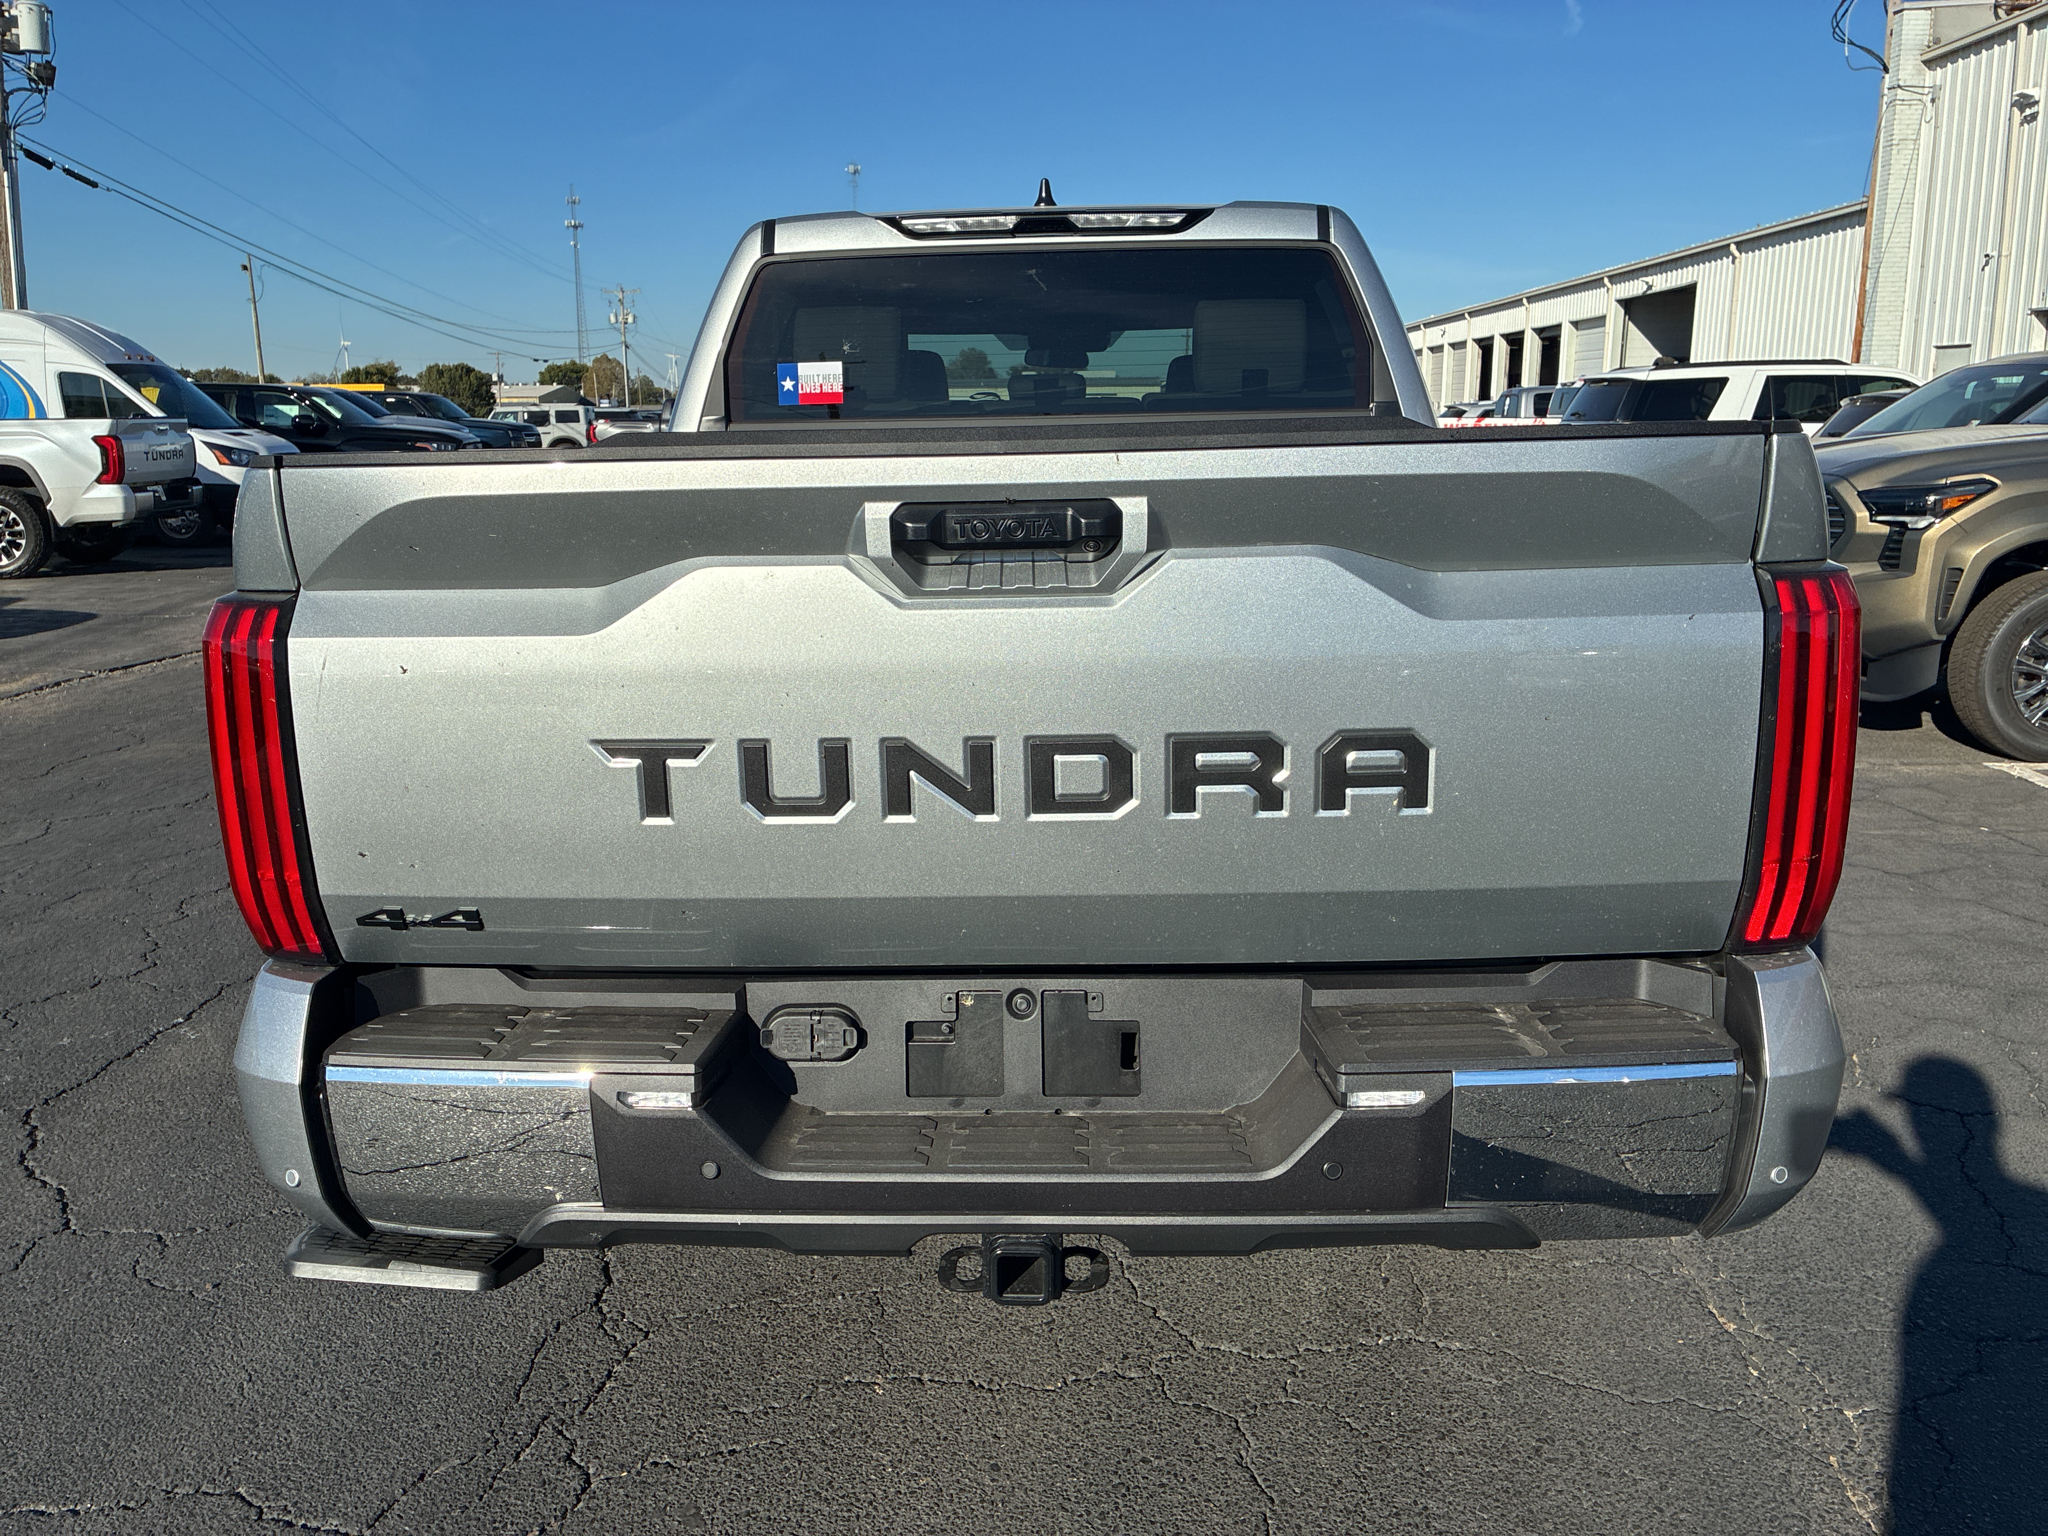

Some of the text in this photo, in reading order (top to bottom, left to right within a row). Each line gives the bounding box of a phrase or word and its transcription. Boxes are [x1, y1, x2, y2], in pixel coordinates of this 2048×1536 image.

[799, 374, 843, 384] BUILT HERE
[799, 382, 843, 393] LIVES HERE
[144, 450, 183, 461] TUNDRA
[954, 518, 1059, 540] TOYOTA
[587, 729, 1436, 825] TUNDRA
